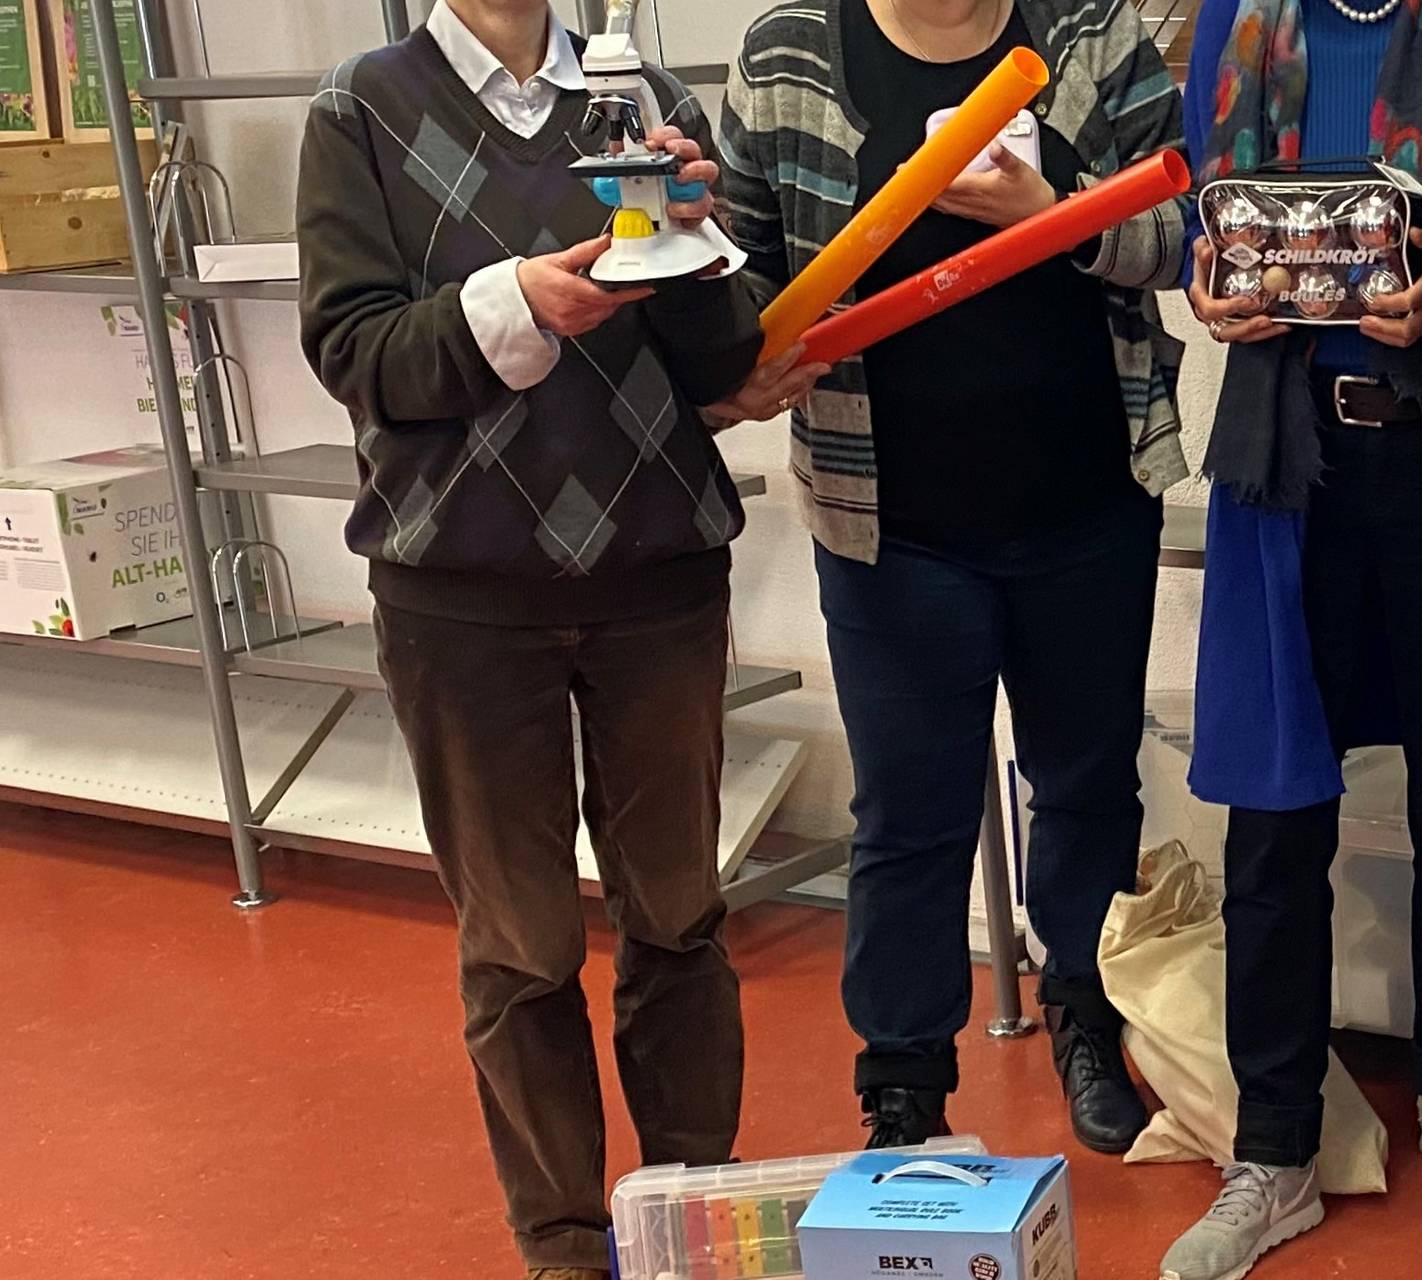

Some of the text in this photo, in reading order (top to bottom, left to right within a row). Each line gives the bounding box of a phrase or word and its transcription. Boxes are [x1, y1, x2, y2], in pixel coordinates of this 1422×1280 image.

[1263, 247, 1378, 265] SCHILDKRÖT
[1279, 287, 1346, 302] BOULES
[115, 502, 177, 532] SPEND
[131, 530, 182, 556] SIE IH
[112, 556, 183, 588] ALT-HA
[1032, 1203, 1058, 1246] KUBB
[879, 1255, 918, 1270] BEX
